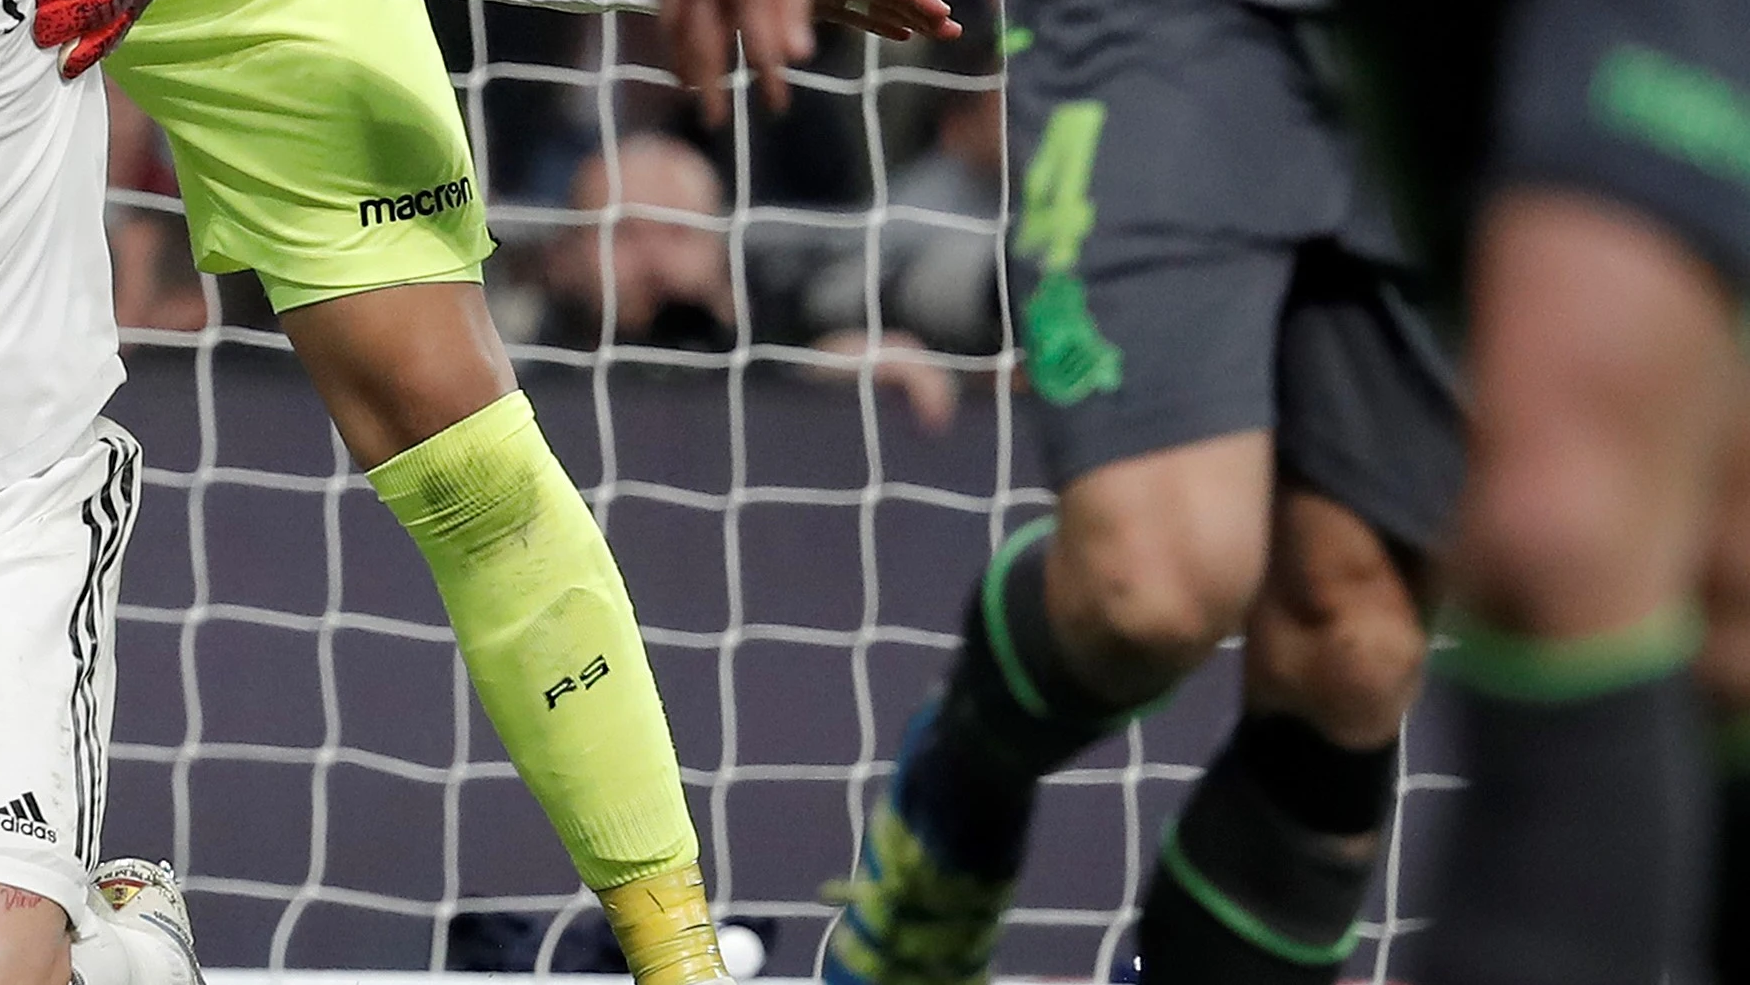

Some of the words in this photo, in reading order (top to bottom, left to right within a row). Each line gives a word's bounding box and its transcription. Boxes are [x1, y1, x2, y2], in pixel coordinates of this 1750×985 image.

[360, 176, 473, 227] macron
[1015, 99, 1110, 266] 4
[545, 654, 610, 711] RS
